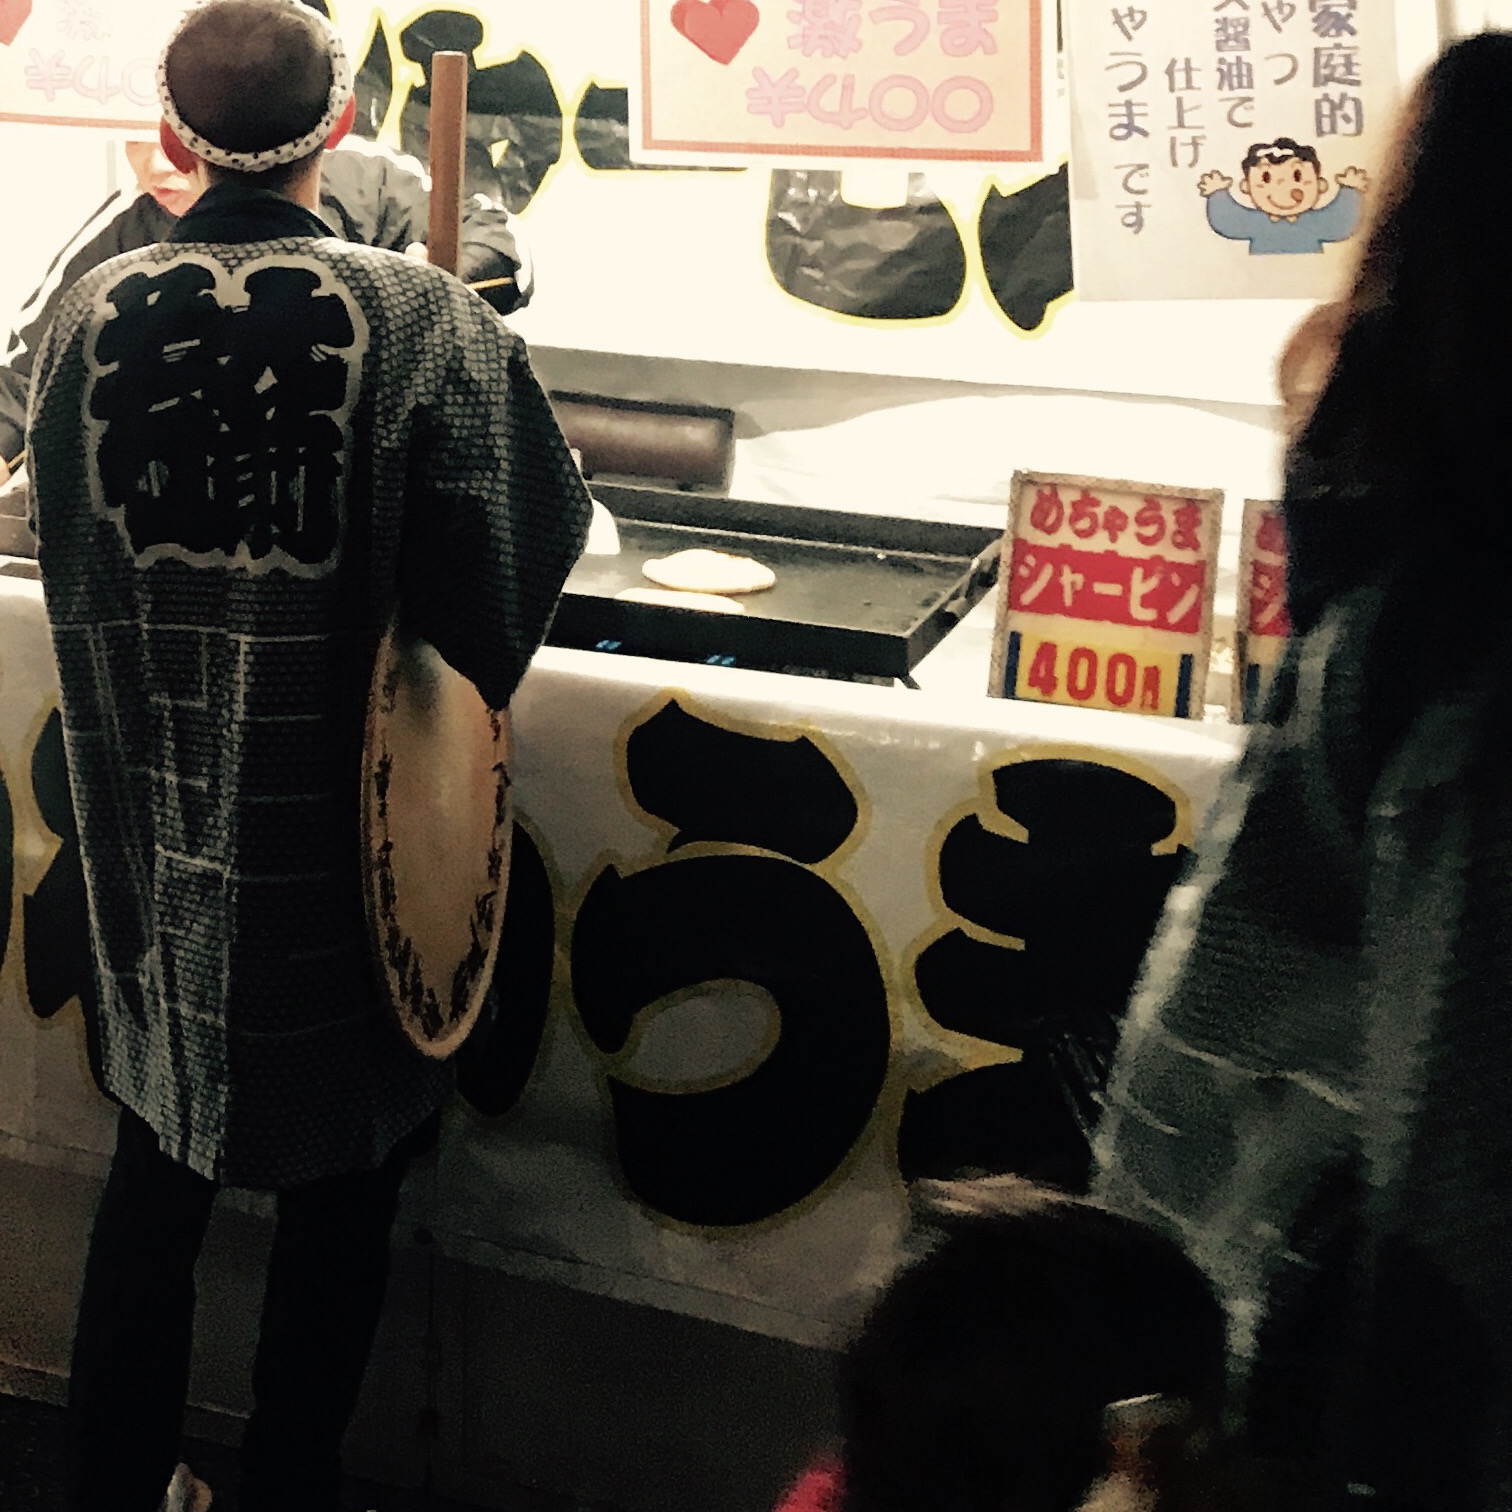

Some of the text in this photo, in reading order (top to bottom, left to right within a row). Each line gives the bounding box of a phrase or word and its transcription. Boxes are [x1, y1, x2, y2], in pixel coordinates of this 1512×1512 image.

[745, 66, 994, 134] ¥400
[1165, 56, 1206, 169] 仕上げ
[1029, 484, 1202, 552] めちゃうま
[1027, 641, 1161, 711] 400円
